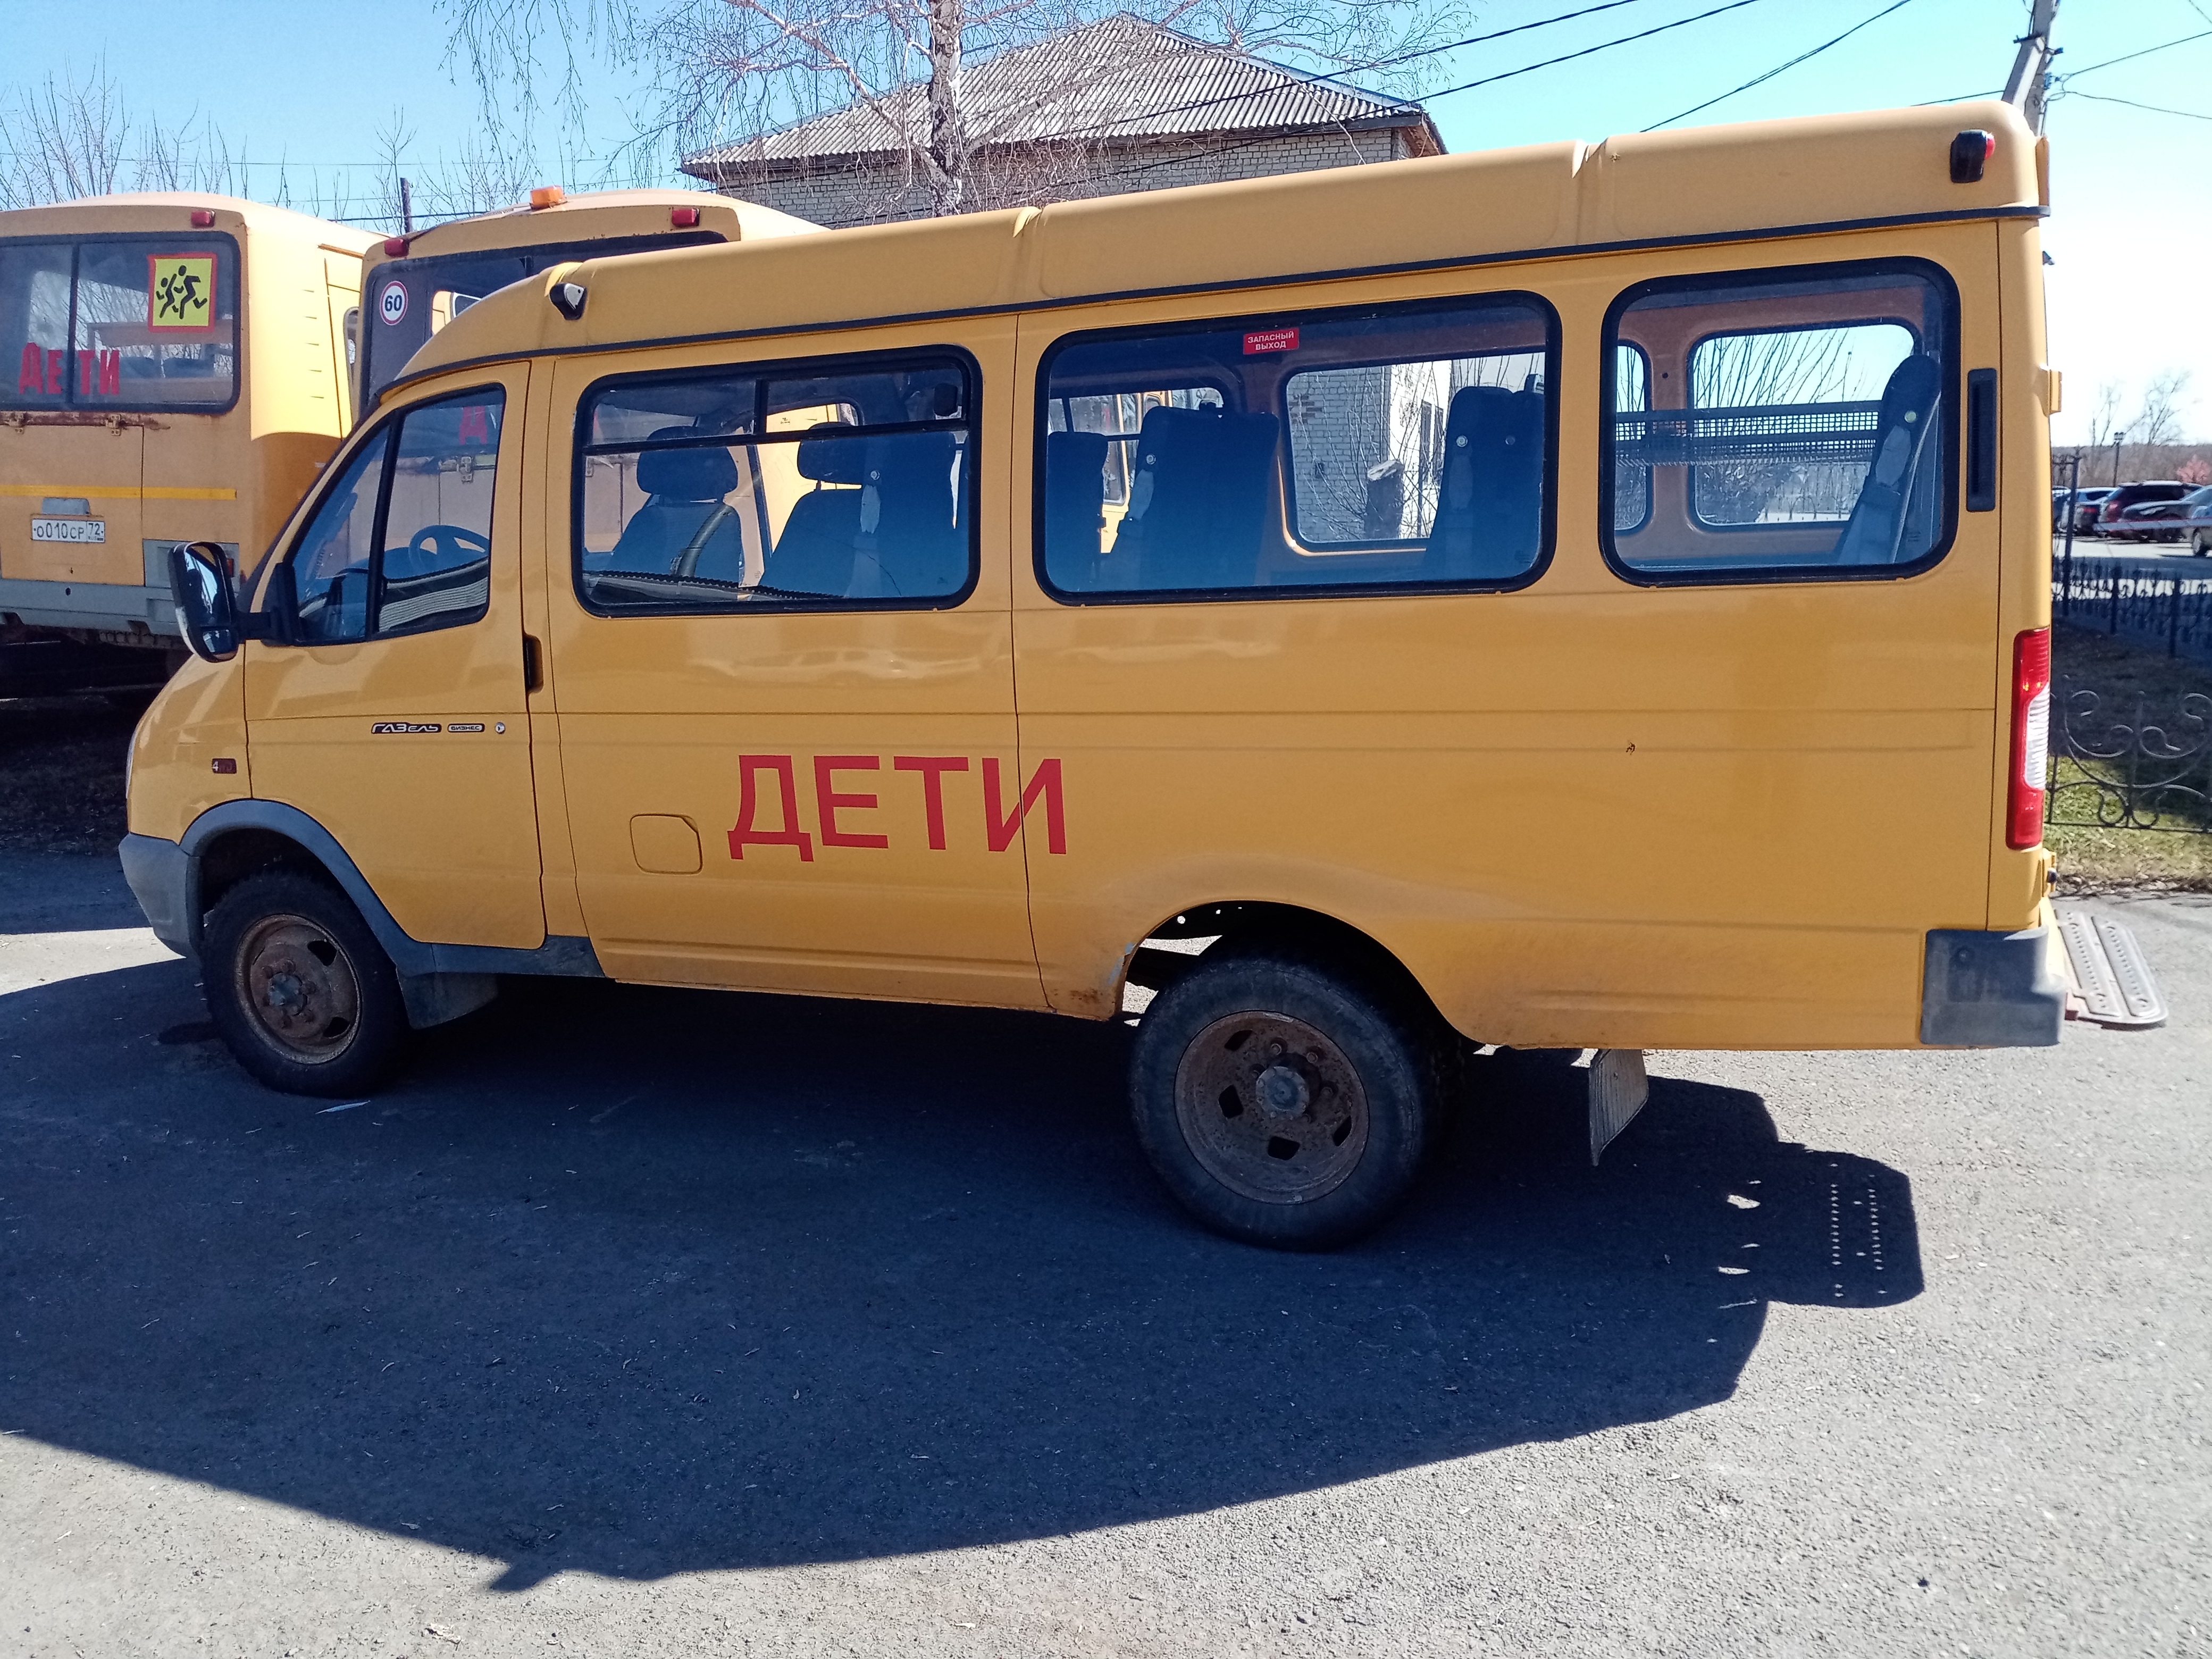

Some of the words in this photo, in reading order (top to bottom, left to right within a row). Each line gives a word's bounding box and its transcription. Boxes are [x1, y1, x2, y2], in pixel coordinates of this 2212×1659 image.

[384, 295, 403, 312] 60
[1247, 331, 1294, 343] ЗАПАСНЫЙ
[1255, 341, 1286, 350] ВЫХОД
[19, 342, 120, 395] ДЕТИ
[88, 523, 100, 535] 72
[727, 755, 1067, 862] ДЕТИ
